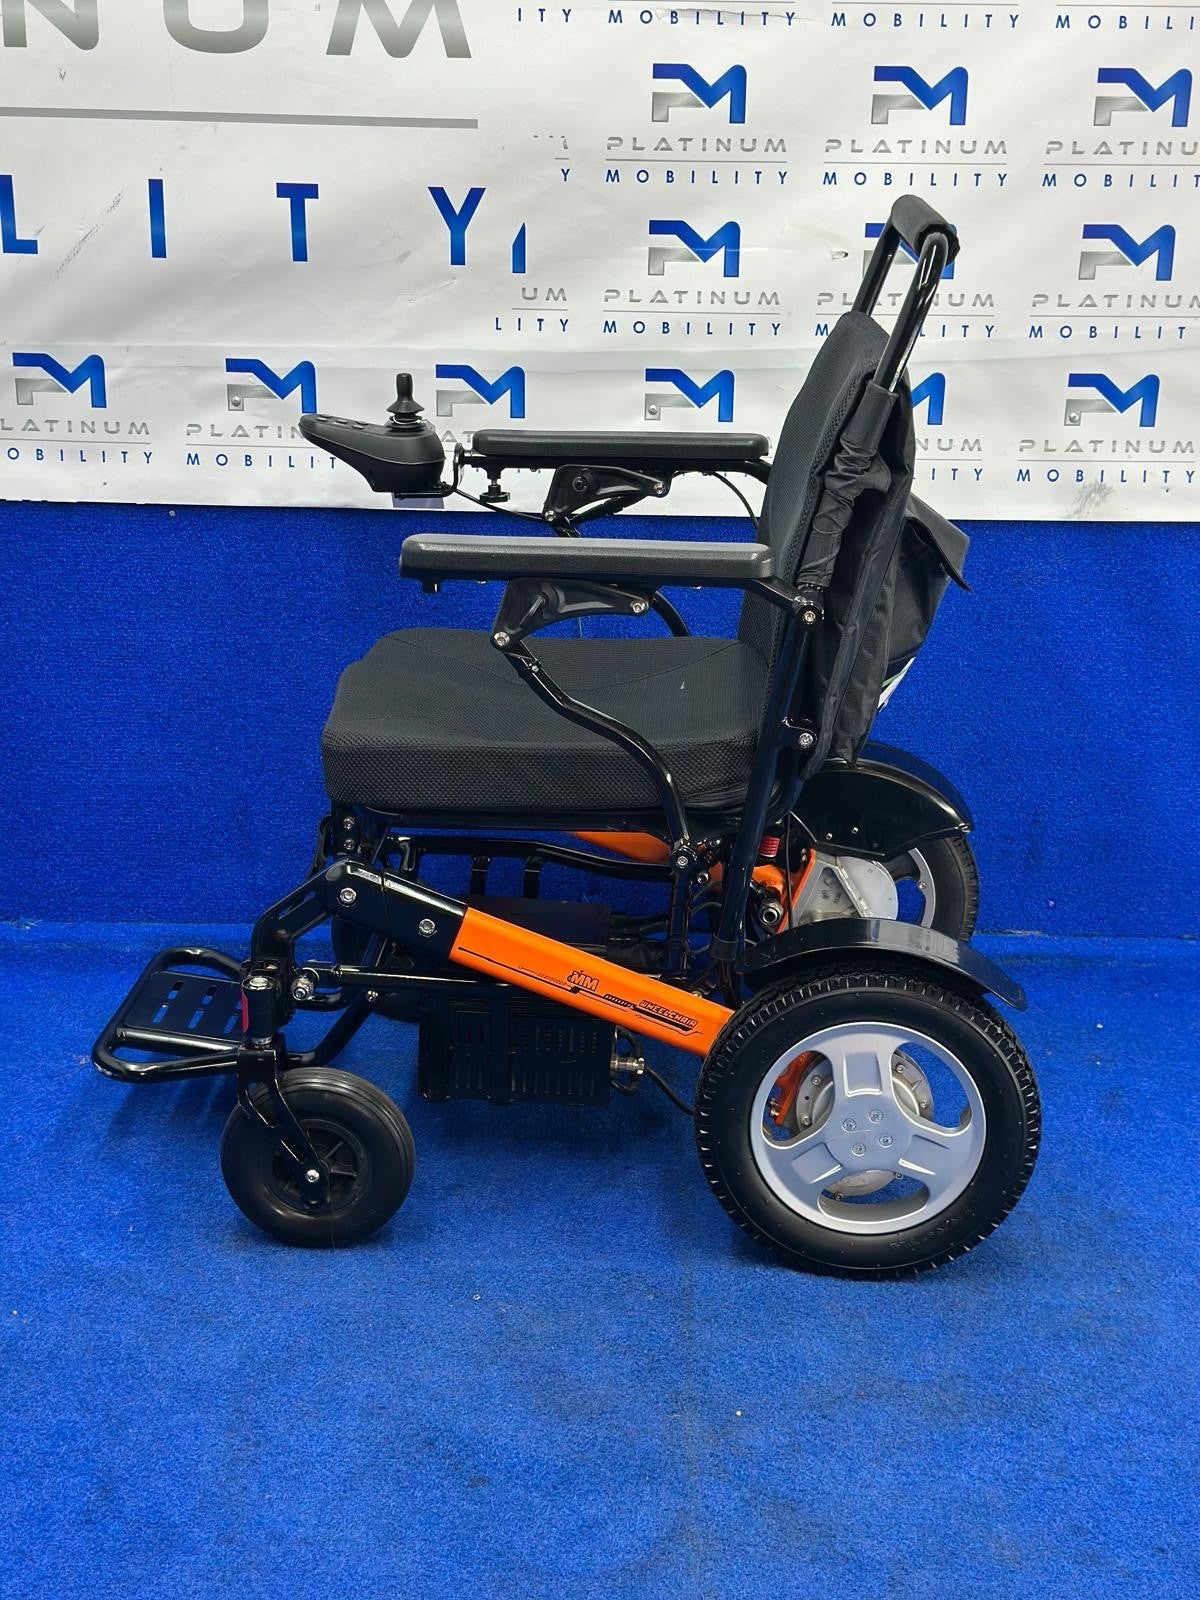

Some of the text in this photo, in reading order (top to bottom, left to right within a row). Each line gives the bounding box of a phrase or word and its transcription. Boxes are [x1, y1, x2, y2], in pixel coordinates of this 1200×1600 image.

[608, 8, 796, 25] MOBILITY
[831, 12, 1019, 28] MOBILITY
[607, 137, 786, 152] PLATINUM
[825, 139, 1007, 154] PLATINUM
[606, 169, 787, 184] MOBILITY
[823, 172, 1007, 187] MOBILITY
[604, 289, 780, 305] PLATINUM
[817, 292, 994, 307] PLTUM
[603, 320, 781, 336] MOBILITY
[1019, 440, 1194, 453] PLATINUM
[1016, 469, 1195, 482] MOBILITY
